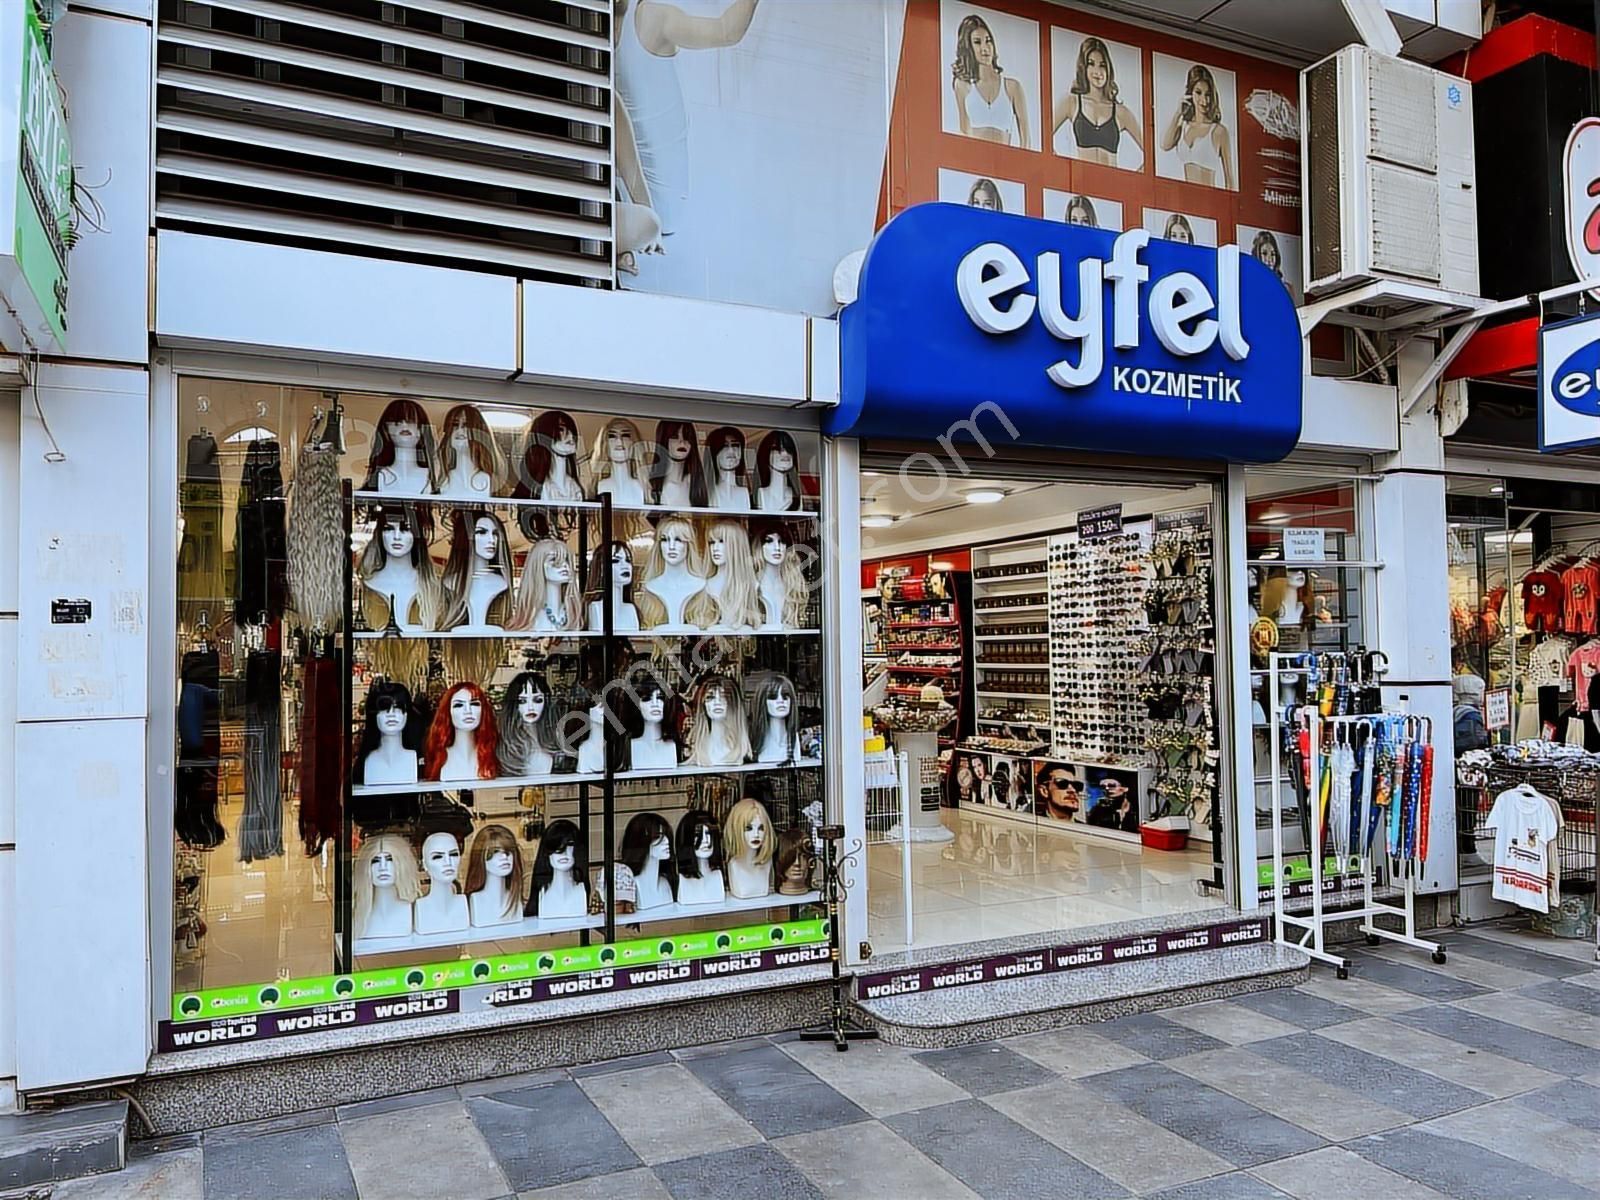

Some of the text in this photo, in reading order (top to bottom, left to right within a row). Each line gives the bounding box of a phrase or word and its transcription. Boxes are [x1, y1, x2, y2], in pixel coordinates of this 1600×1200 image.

[957, 228, 1250, 388] eyfel
[1113, 366, 1242, 403] KOZMETİK
[1299, 881, 1334, 893] WOLD
[1167, 936, 1208, 950] WORLD
[1222, 928, 1261, 943] WORLD
[775, 948, 830, 964] WORLD
[1057, 951, 1103, 967] WORLD
[1114, 944, 1157, 958] WORLD
[703, 958, 761, 974] WORLD
[995, 962, 1043, 977] WORLD
[630, 966, 691, 984] WORLD
[933, 971, 983, 987] WORLD
[549, 977, 614, 995] WORLD
[375, 998, 448, 1018] WORLD
[277, 1010, 356, 1032] WORLD
[173, 1024, 257, 1046] WORLD
